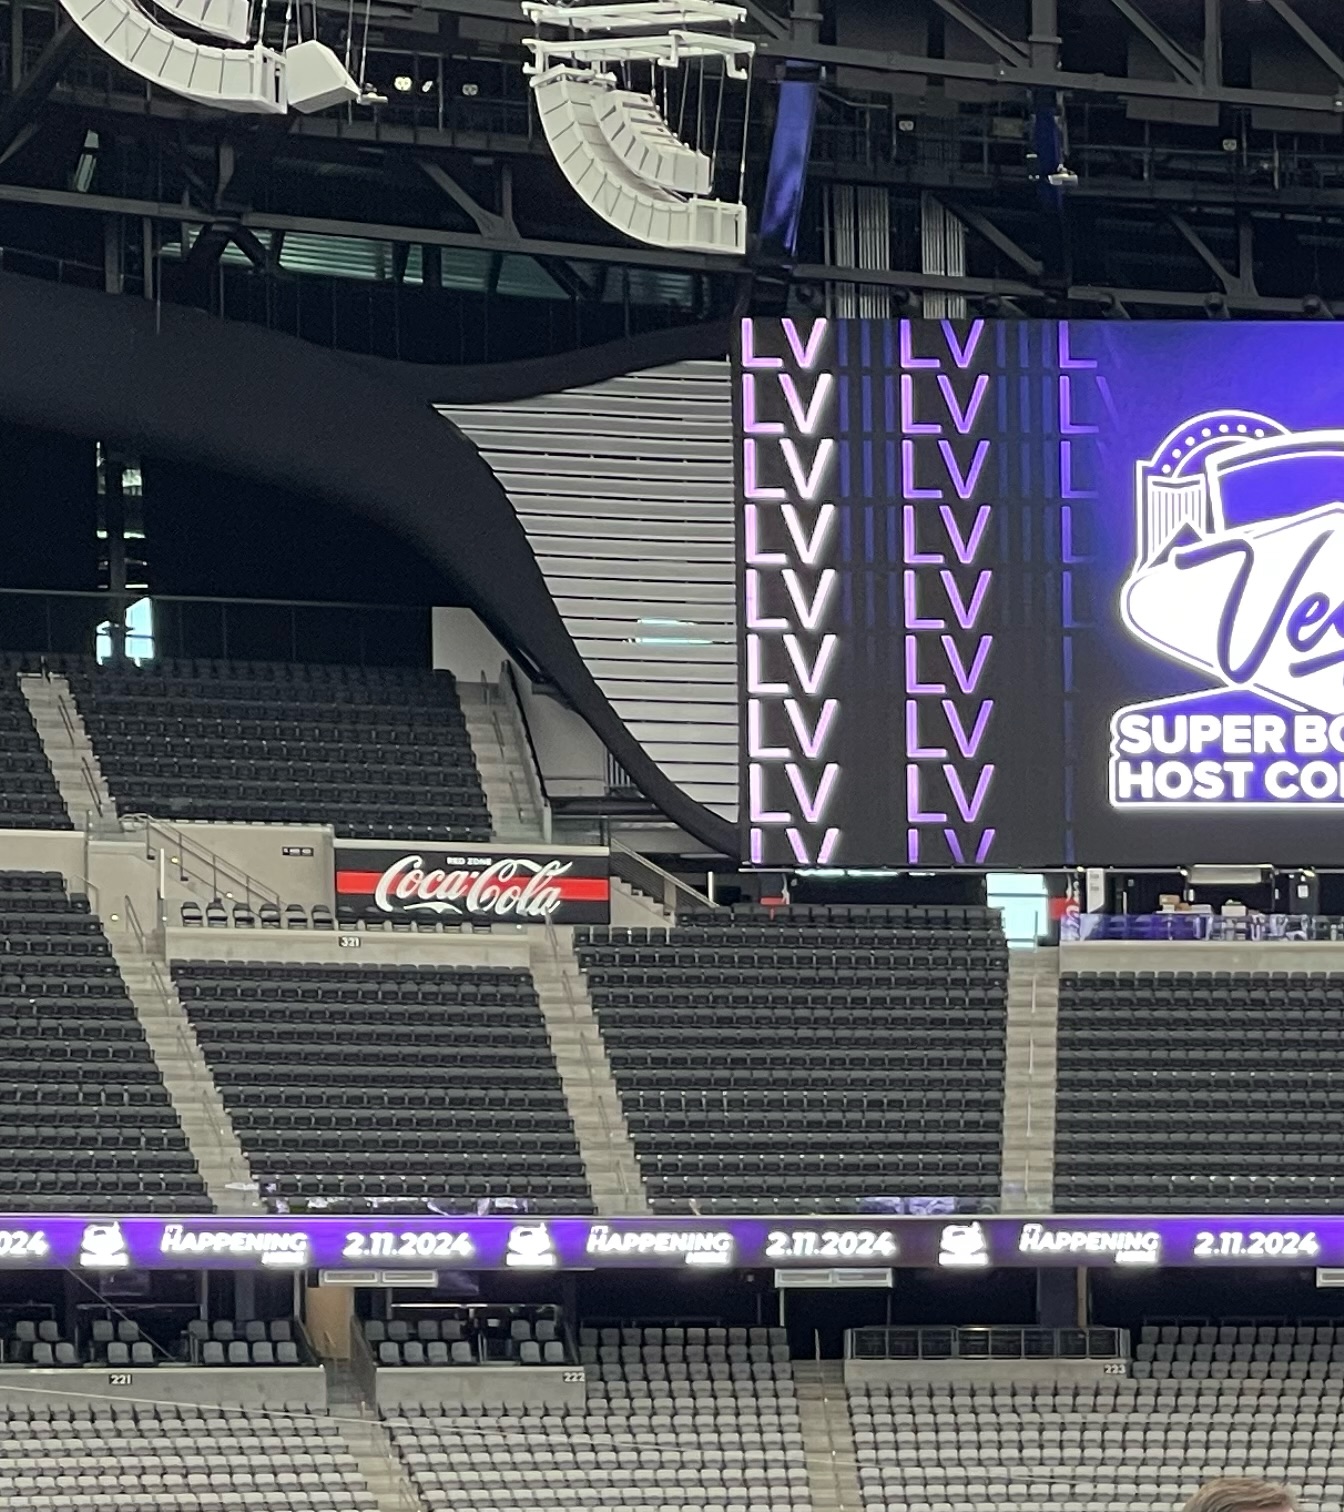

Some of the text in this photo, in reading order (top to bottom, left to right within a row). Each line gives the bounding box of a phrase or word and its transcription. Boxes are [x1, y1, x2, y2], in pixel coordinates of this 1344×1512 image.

[1119, 713, 1285, 755] SUPER
[1119, 760, 1257, 800] HOST
[341, 937, 360, 947] 321
[344, 1233, 473, 1256] 2.11.2024
[766, 1232, 895, 1255] 2.11.2024
[1195, 1233, 1318, 1255] 2.11.2024
[111, 1374, 131, 1384] 221
[563, 1372, 585, 1382] 222
[1104, 1365, 1126, 1373] 223
